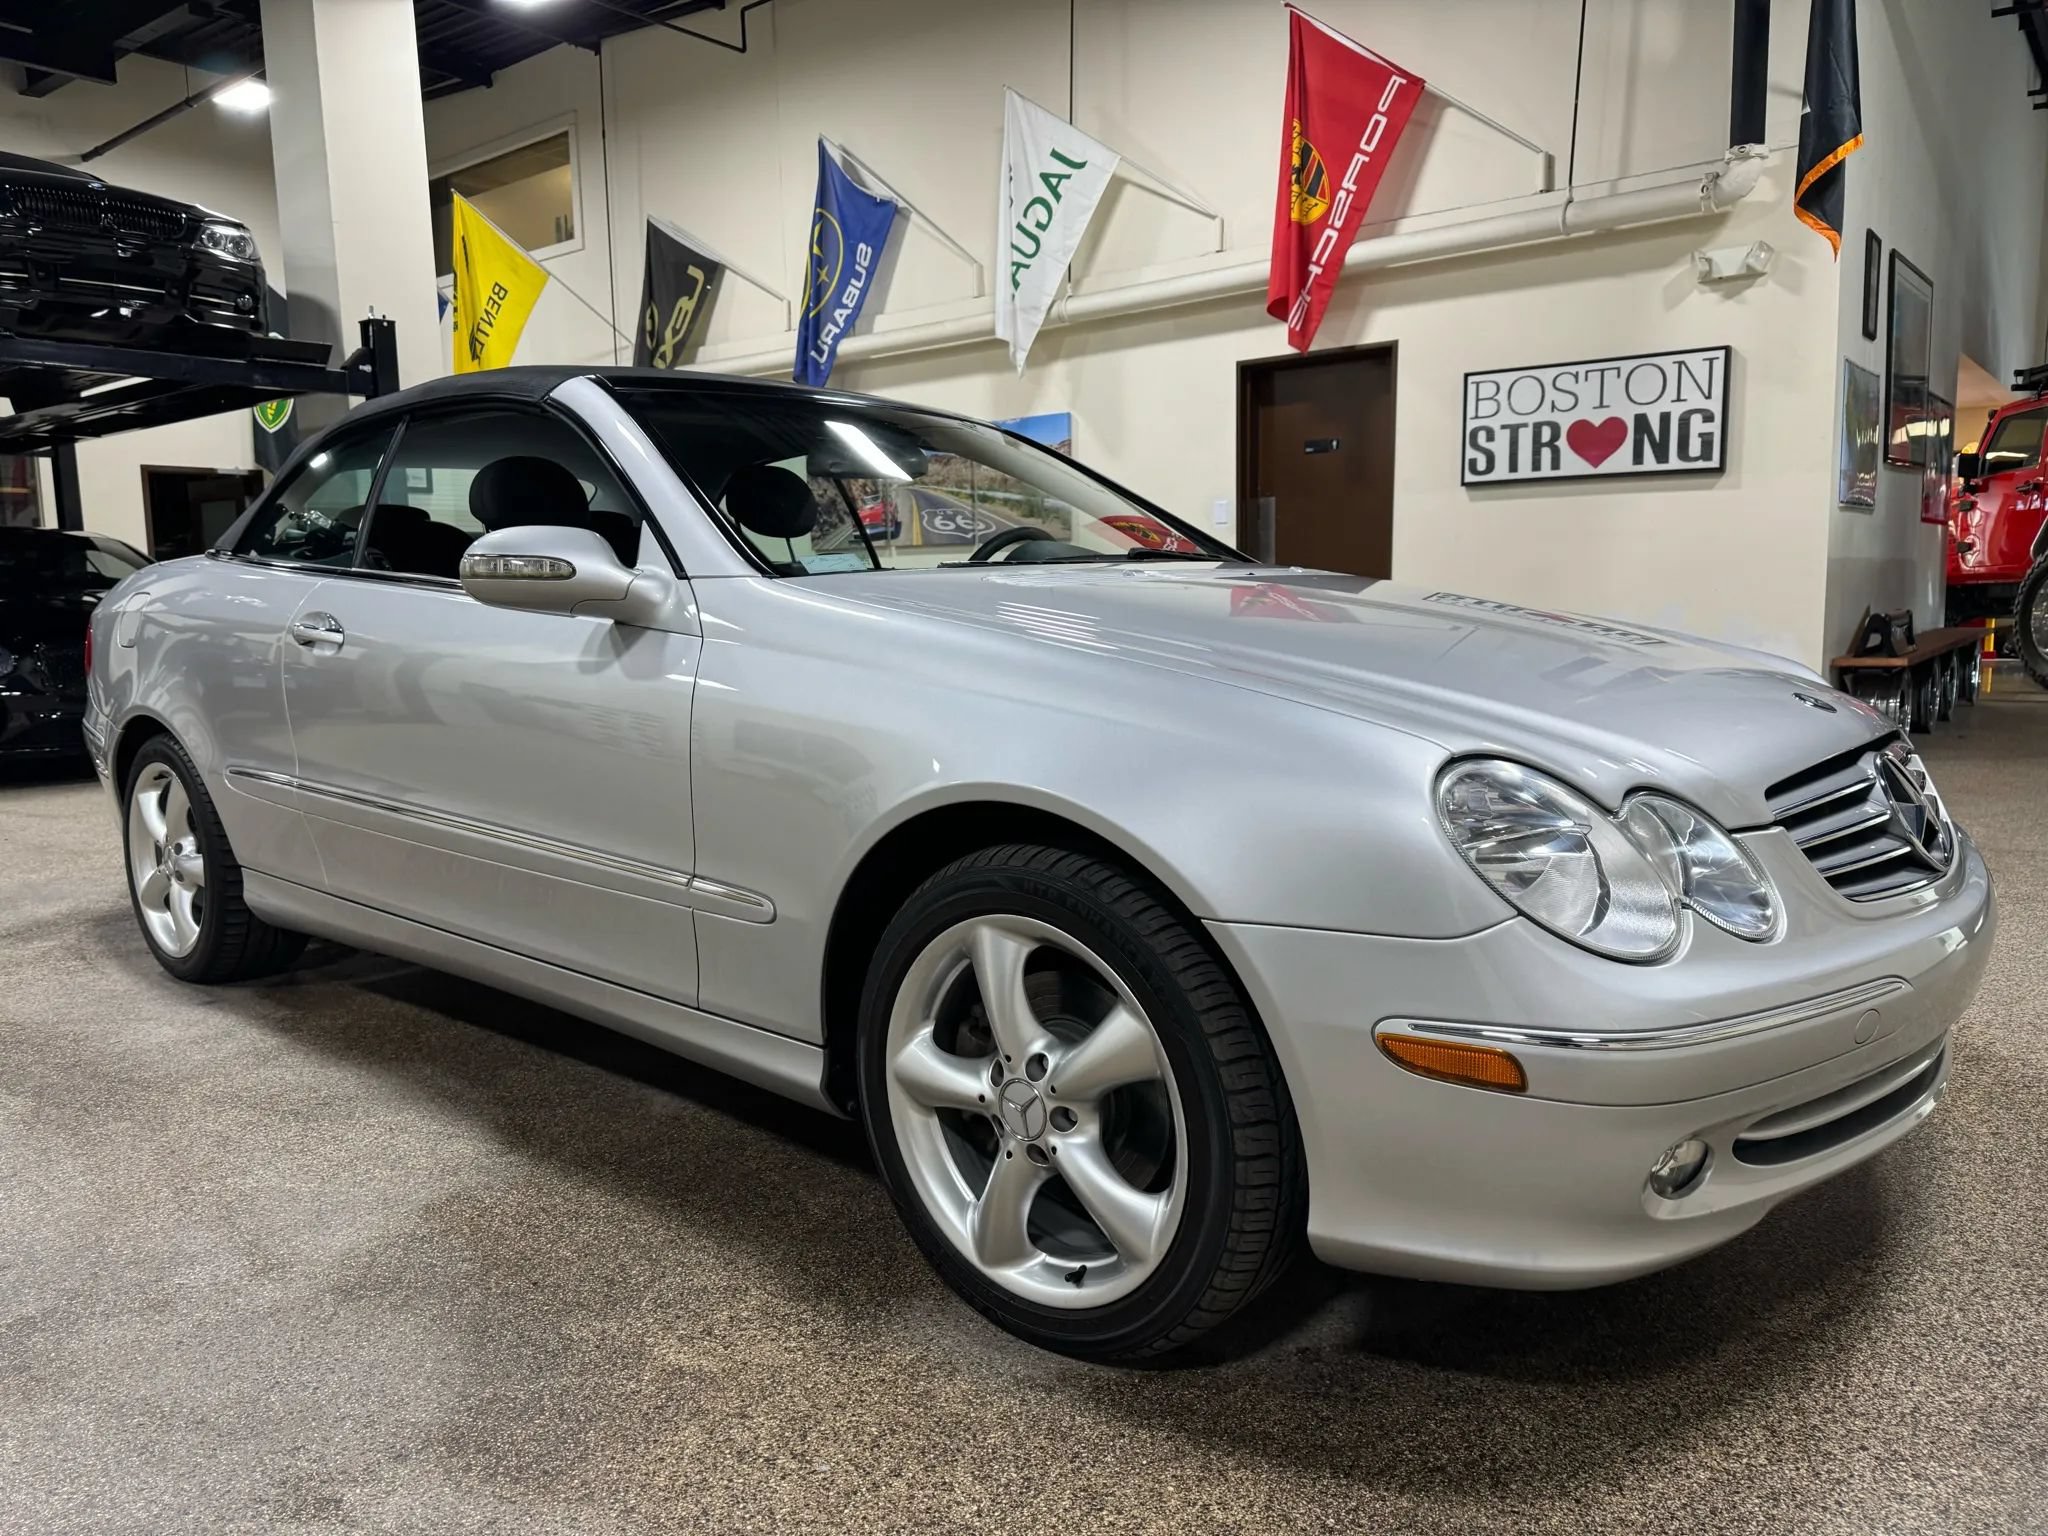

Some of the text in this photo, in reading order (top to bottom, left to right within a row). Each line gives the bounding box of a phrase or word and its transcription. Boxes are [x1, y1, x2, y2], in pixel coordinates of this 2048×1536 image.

[1469, 356, 1720, 420] BOSTON
[1467, 408, 1716, 476] STRNG
[934, 515, 986, 530] 66
